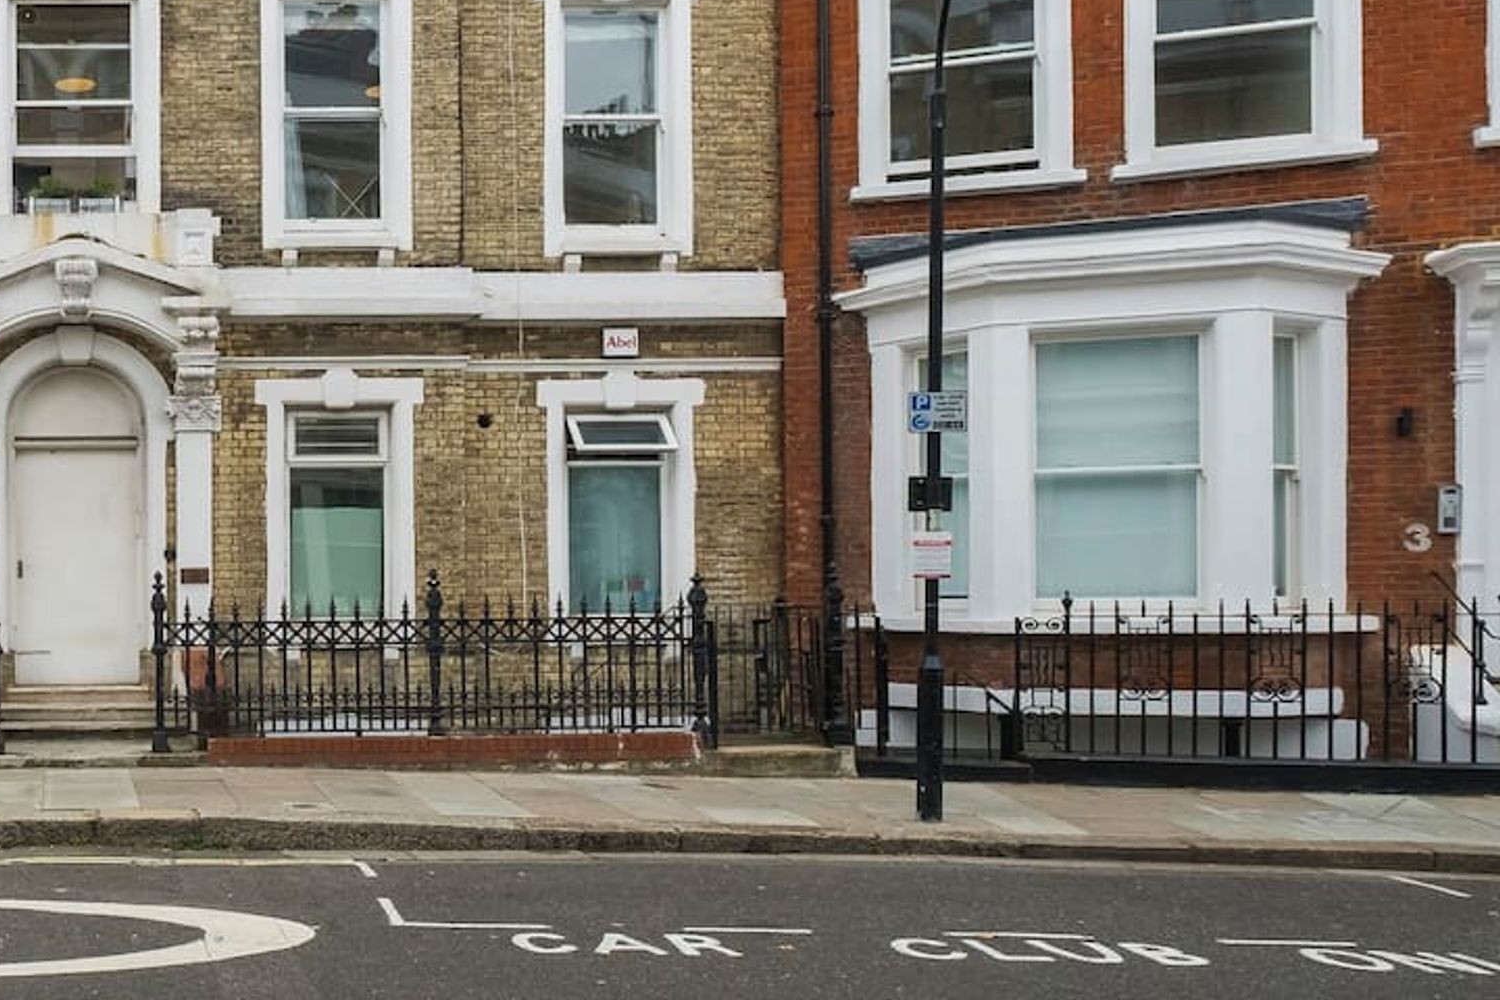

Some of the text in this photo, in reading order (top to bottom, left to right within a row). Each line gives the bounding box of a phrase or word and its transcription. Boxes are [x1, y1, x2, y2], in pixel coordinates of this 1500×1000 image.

[605, 335, 637, 349] Abel
[1403, 522, 1432, 552] 3
[510, 932, 744, 957] CAR
[890, 937, 1211, 966] CLUB
